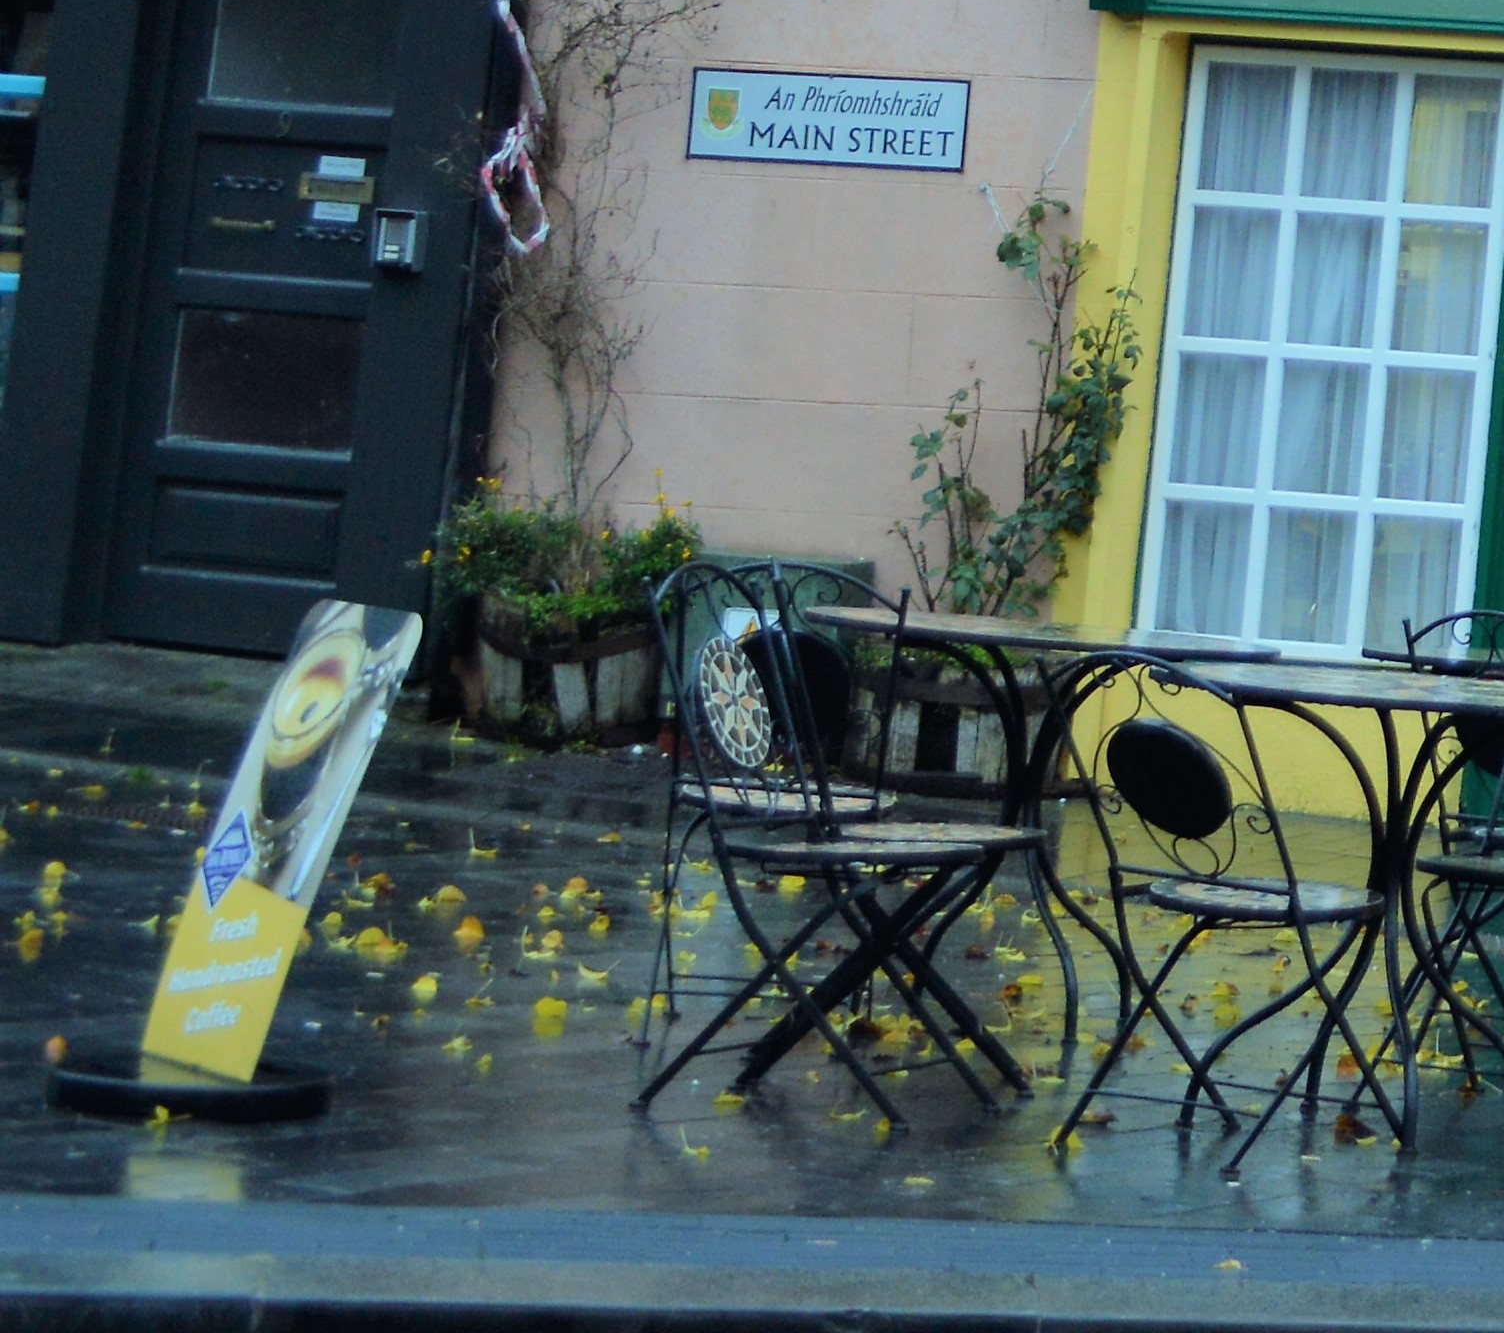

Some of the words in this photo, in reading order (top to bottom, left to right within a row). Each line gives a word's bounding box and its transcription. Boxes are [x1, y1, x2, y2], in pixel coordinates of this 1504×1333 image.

[764, 85, 796, 112] An
[800, 86, 944, 119] Phríomhshráid
[748, 120, 836, 152] MAIN
[847, 127, 956, 158] STREET
